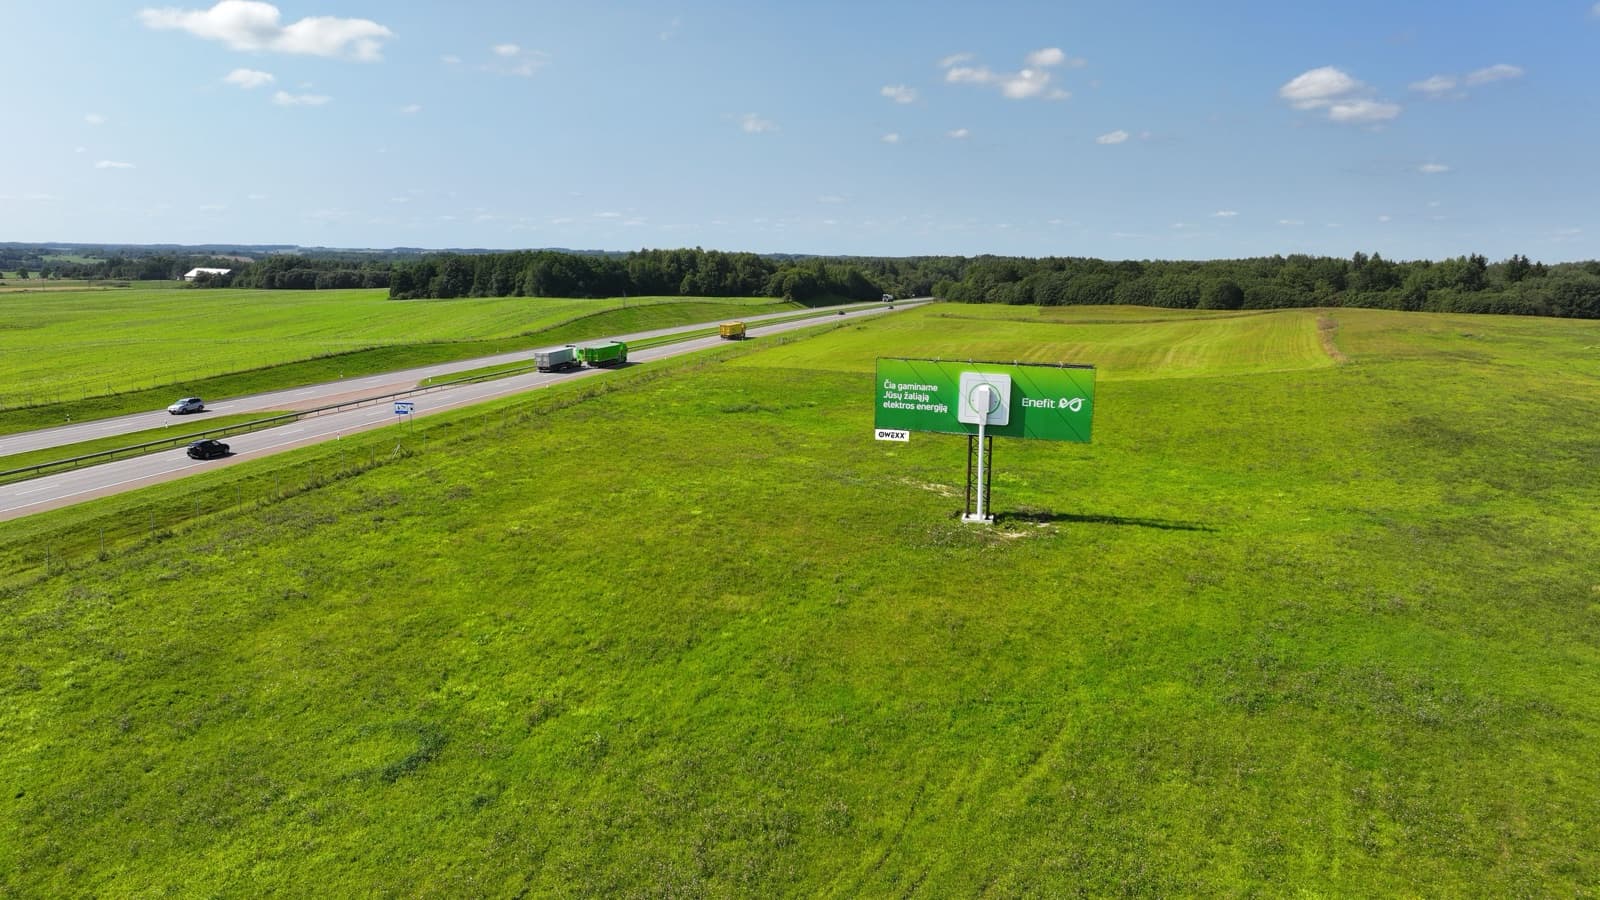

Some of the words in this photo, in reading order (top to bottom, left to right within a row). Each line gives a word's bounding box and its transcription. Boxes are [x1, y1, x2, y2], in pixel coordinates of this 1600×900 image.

[884, 379, 896, 389] Čia
[897, 383, 938, 392] gaminame
[883, 401, 915, 410] elektros
[916, 403, 948, 413] energiją
[1022, 397, 1056, 408] Enefit
